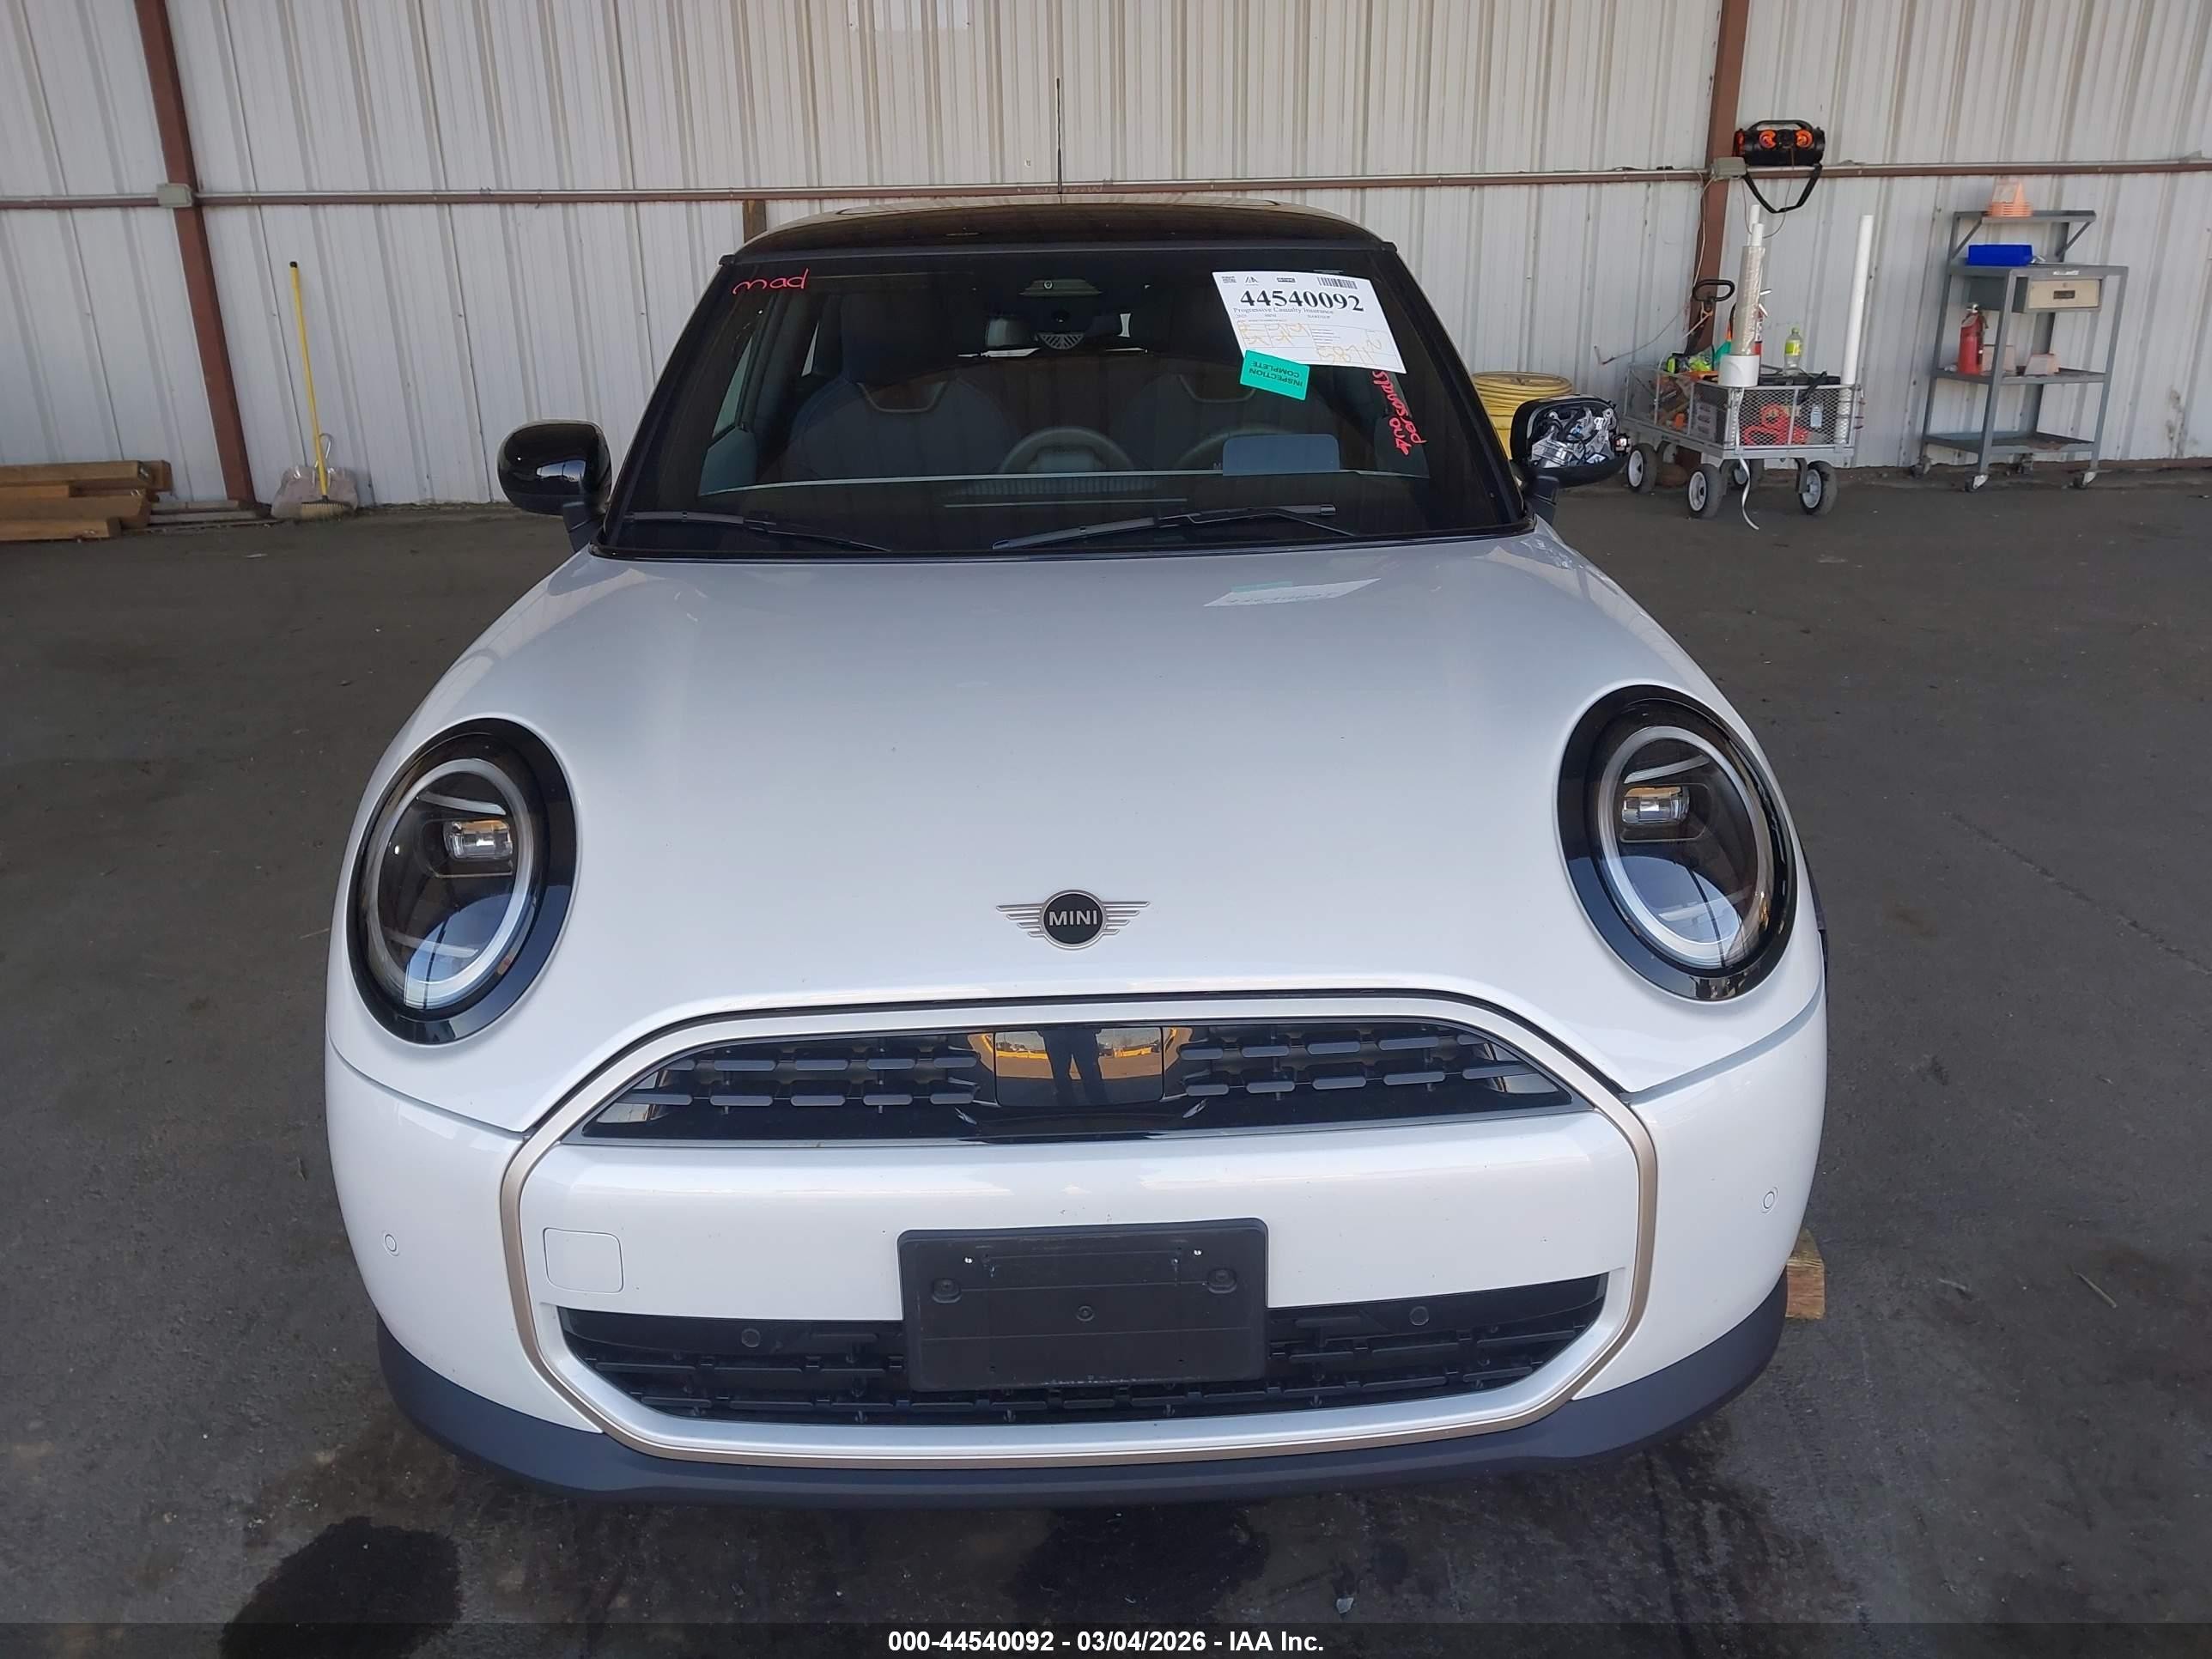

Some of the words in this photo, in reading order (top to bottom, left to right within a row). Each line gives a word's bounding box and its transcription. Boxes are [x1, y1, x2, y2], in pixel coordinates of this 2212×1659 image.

[732, 268, 810, 295] mad
[1240, 289, 1364, 312] 44540092
[1249, 368, 1303, 387] INSPECTION
[1251, 361, 1300, 378] COMPLETE
[1048, 910, 1097, 926] MINI
